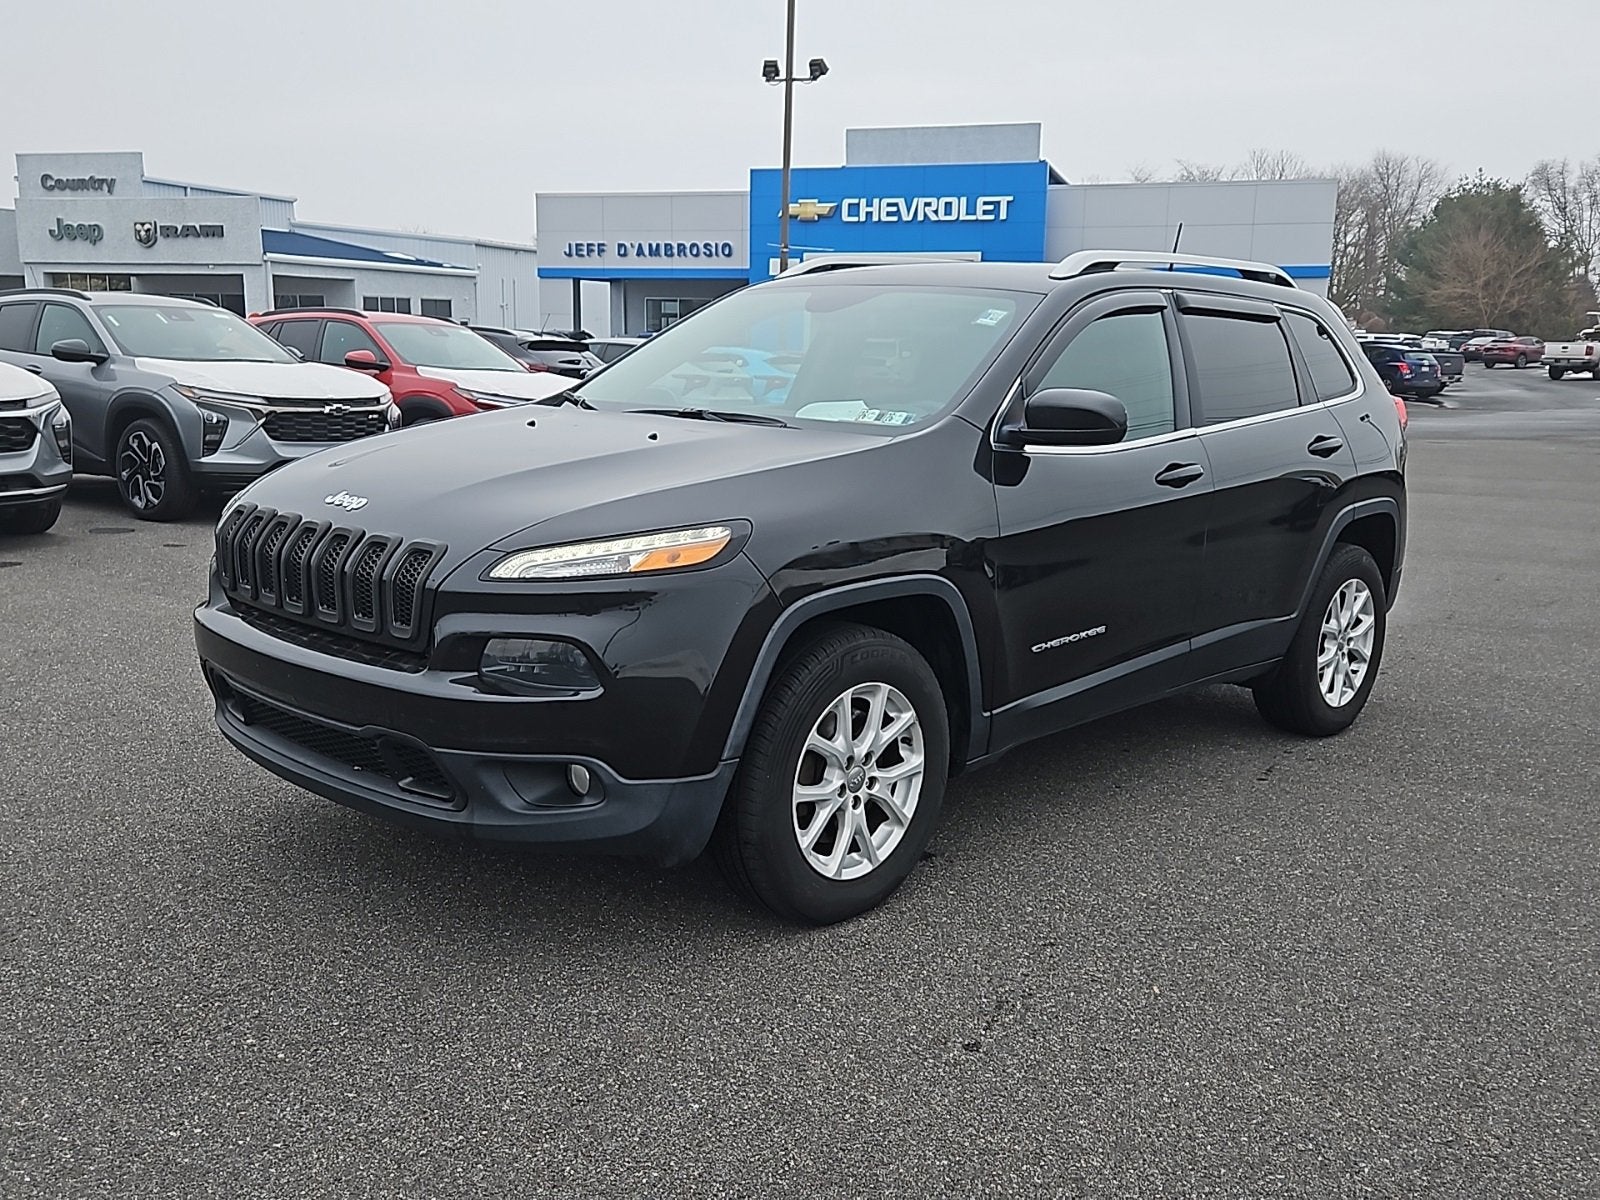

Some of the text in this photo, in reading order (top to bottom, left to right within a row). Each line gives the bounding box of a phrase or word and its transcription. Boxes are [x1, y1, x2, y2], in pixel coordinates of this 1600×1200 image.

[40, 173, 116, 195] Country
[841, 195, 1014, 223] CHEVROLET
[48, 217, 104, 246] Jeep
[159, 224, 224, 239] RAM
[563, 242, 734, 258] JEFF D'AMBROSIO
[324, 489, 369, 512] Jeep
[1031, 625, 1107, 653] CHEROKEE
